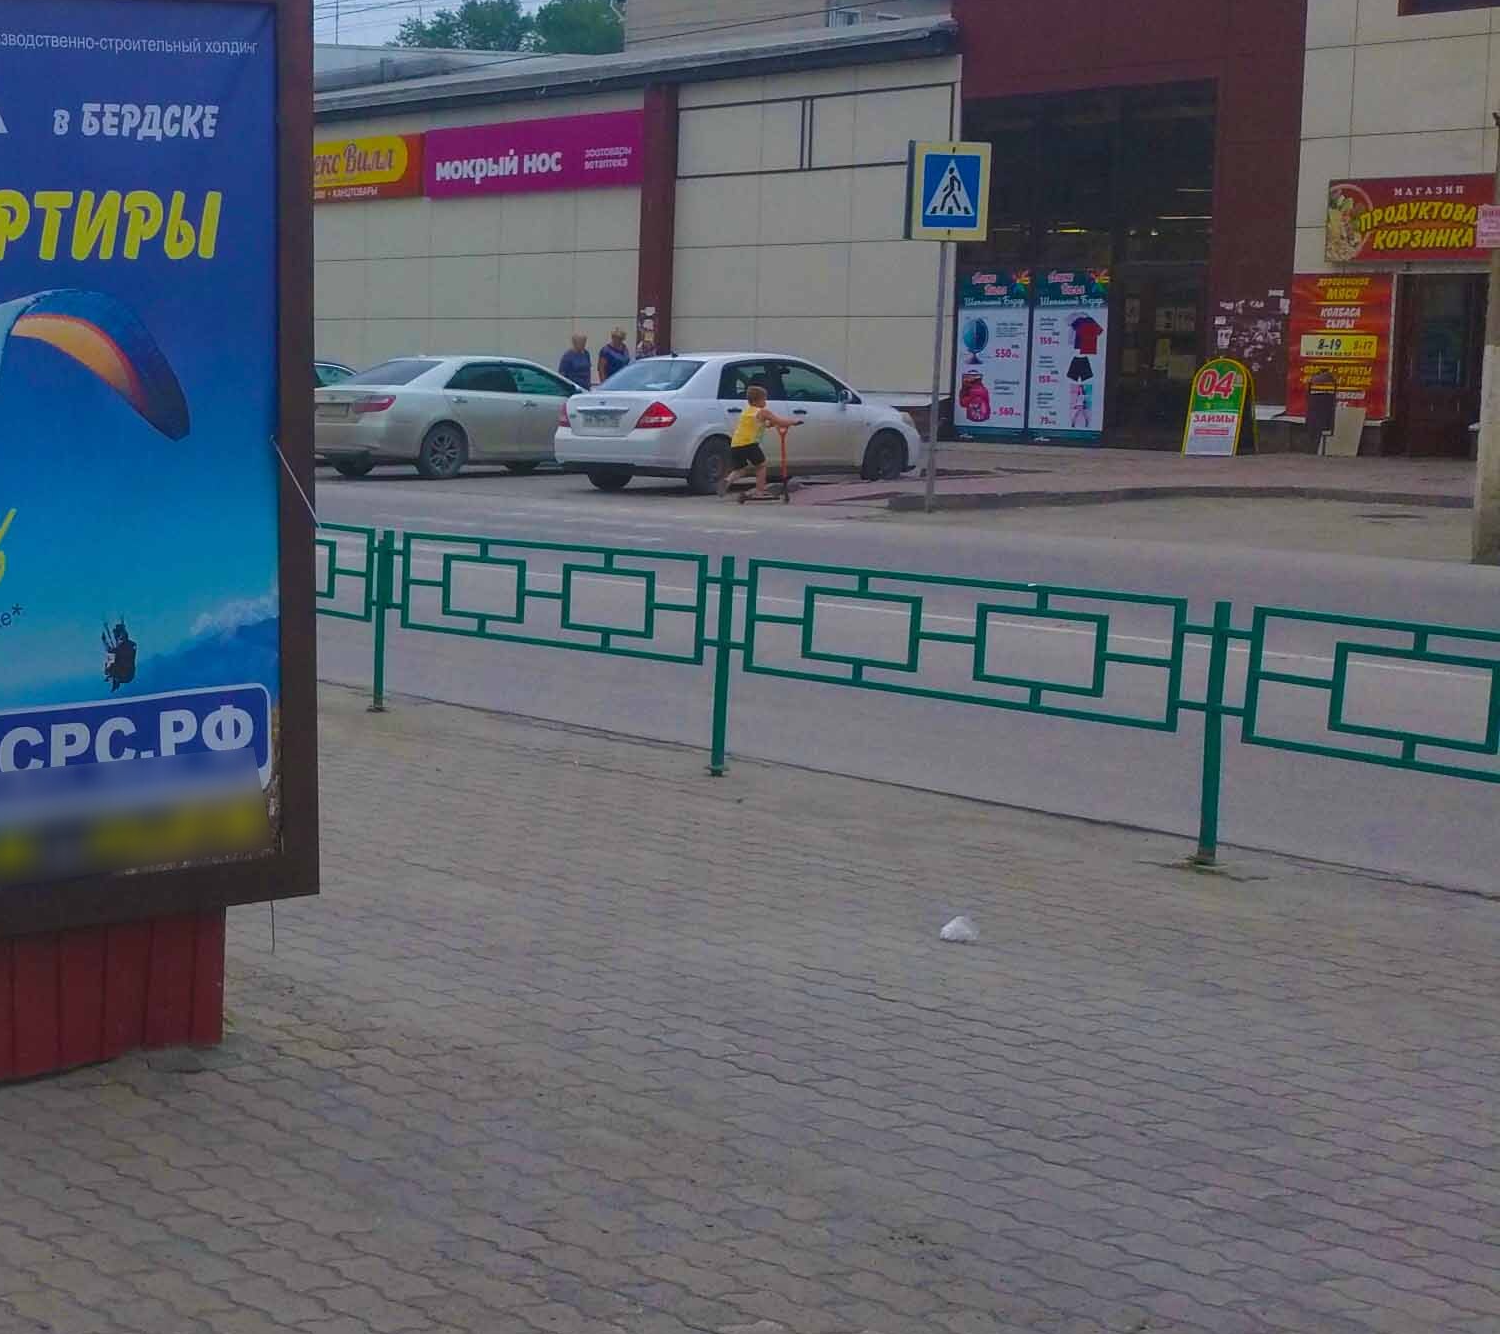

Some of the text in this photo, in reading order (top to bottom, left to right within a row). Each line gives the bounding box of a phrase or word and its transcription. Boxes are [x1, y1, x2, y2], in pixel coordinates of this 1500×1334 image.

[204, 39, 259, 57] холдинг
[53, 102, 220, 141] в БЕРДСКЕ
[435, 149, 563, 184] мокрый нос
[1393, 185, 1465, 197] МАГАЗИН
[1358, 201, 1477, 232] ПРОДУКТОВА
[1372, 227, 1475, 250] КОРЗИНКА
[1320, 306, 1361, 318] КОЛБАСА
